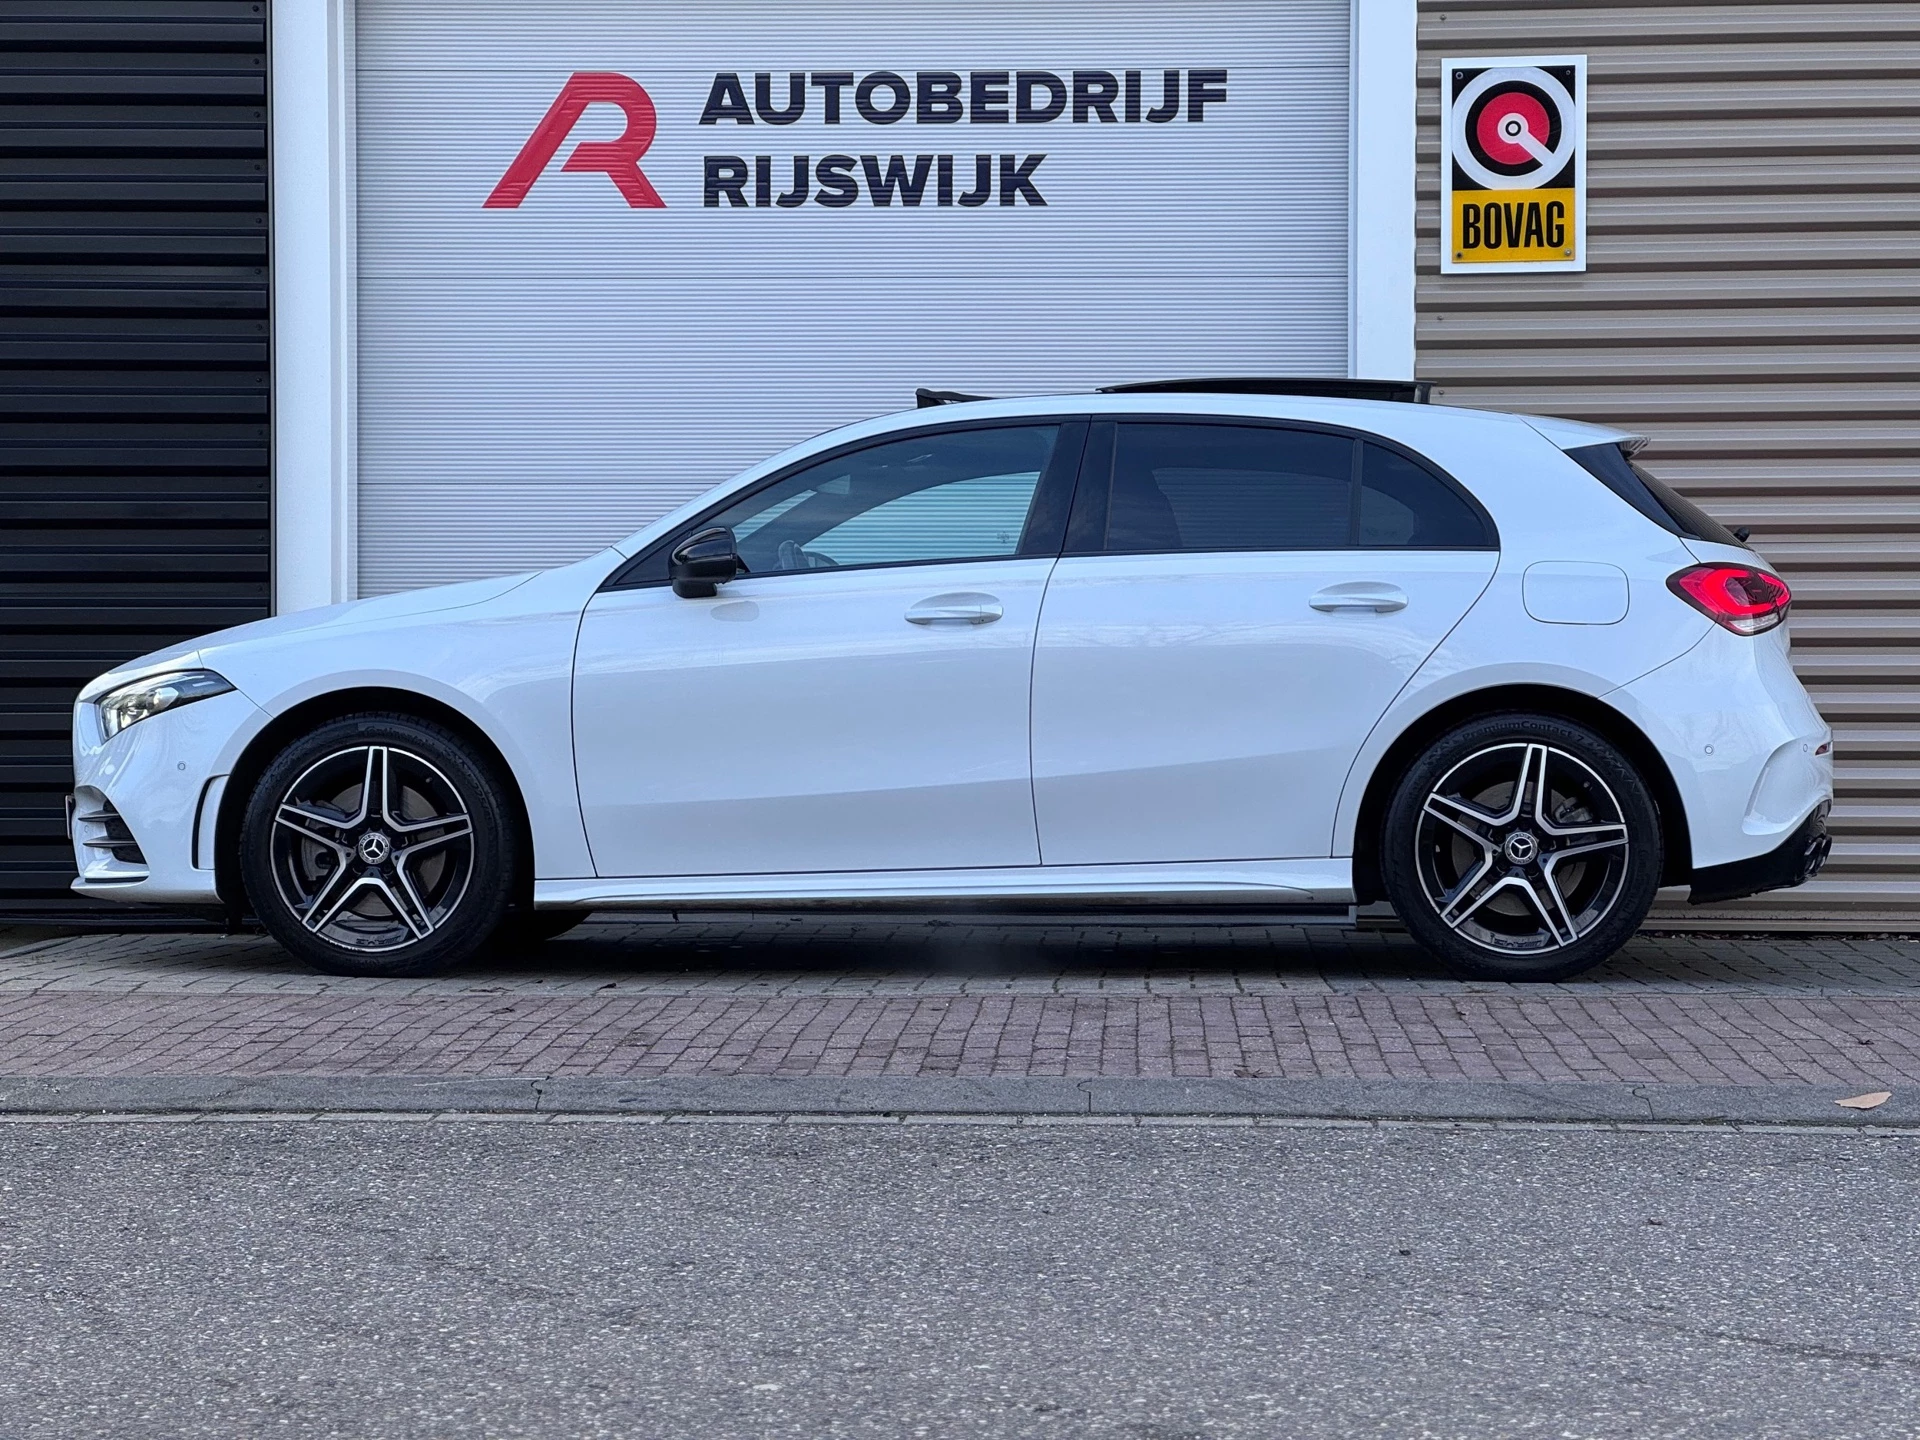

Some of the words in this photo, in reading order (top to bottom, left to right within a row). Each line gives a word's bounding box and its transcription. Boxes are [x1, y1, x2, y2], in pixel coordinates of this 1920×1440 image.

[699, 69, 1229, 126] AUTOBEDRIJF
[703, 153, 1049, 209] RIJSWIJK
[1462, 200, 1565, 249] BOVAG
[1462, 720, 1572, 741] PremiumContact
[1576, 734, 1586, 743] 7
